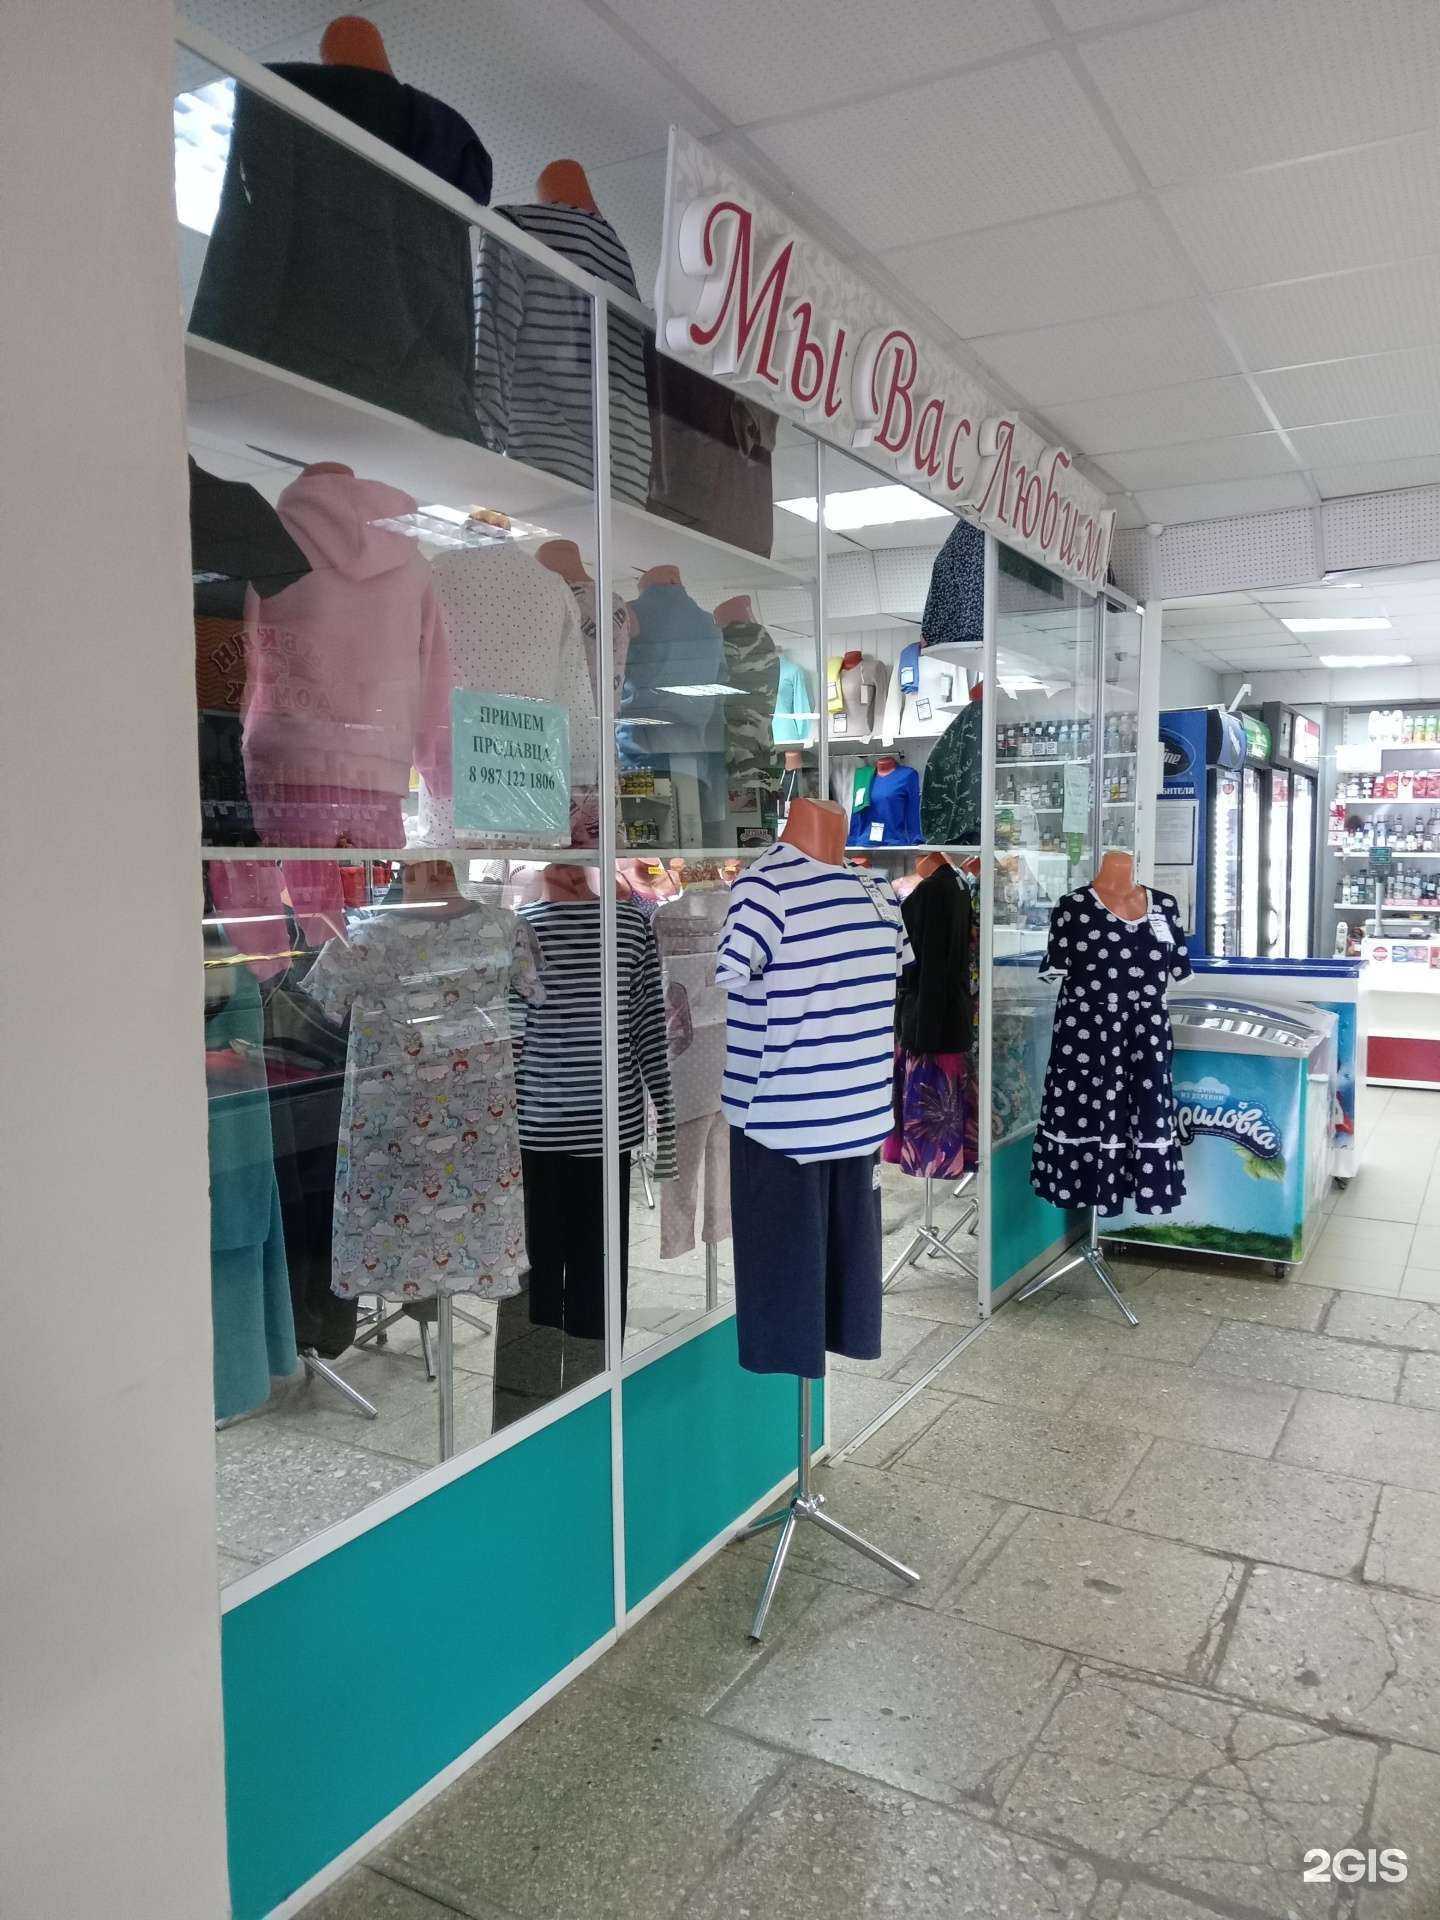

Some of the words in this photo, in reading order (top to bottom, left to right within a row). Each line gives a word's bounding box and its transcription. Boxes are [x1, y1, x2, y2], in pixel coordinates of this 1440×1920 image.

[690, 202, 846, 418] Мы
[872, 330, 971, 491] Вас
[480, 706, 545, 732] ПРИМЕМ
[473, 735, 552, 762] ПРОДАВЦА
[469, 765, 477, 783] 8
[480, 767, 503, 785] 987
[507, 770, 526, 787] 122
[530, 773, 556, 790] 1806
[1178, 1101, 1276, 1150] риловка
